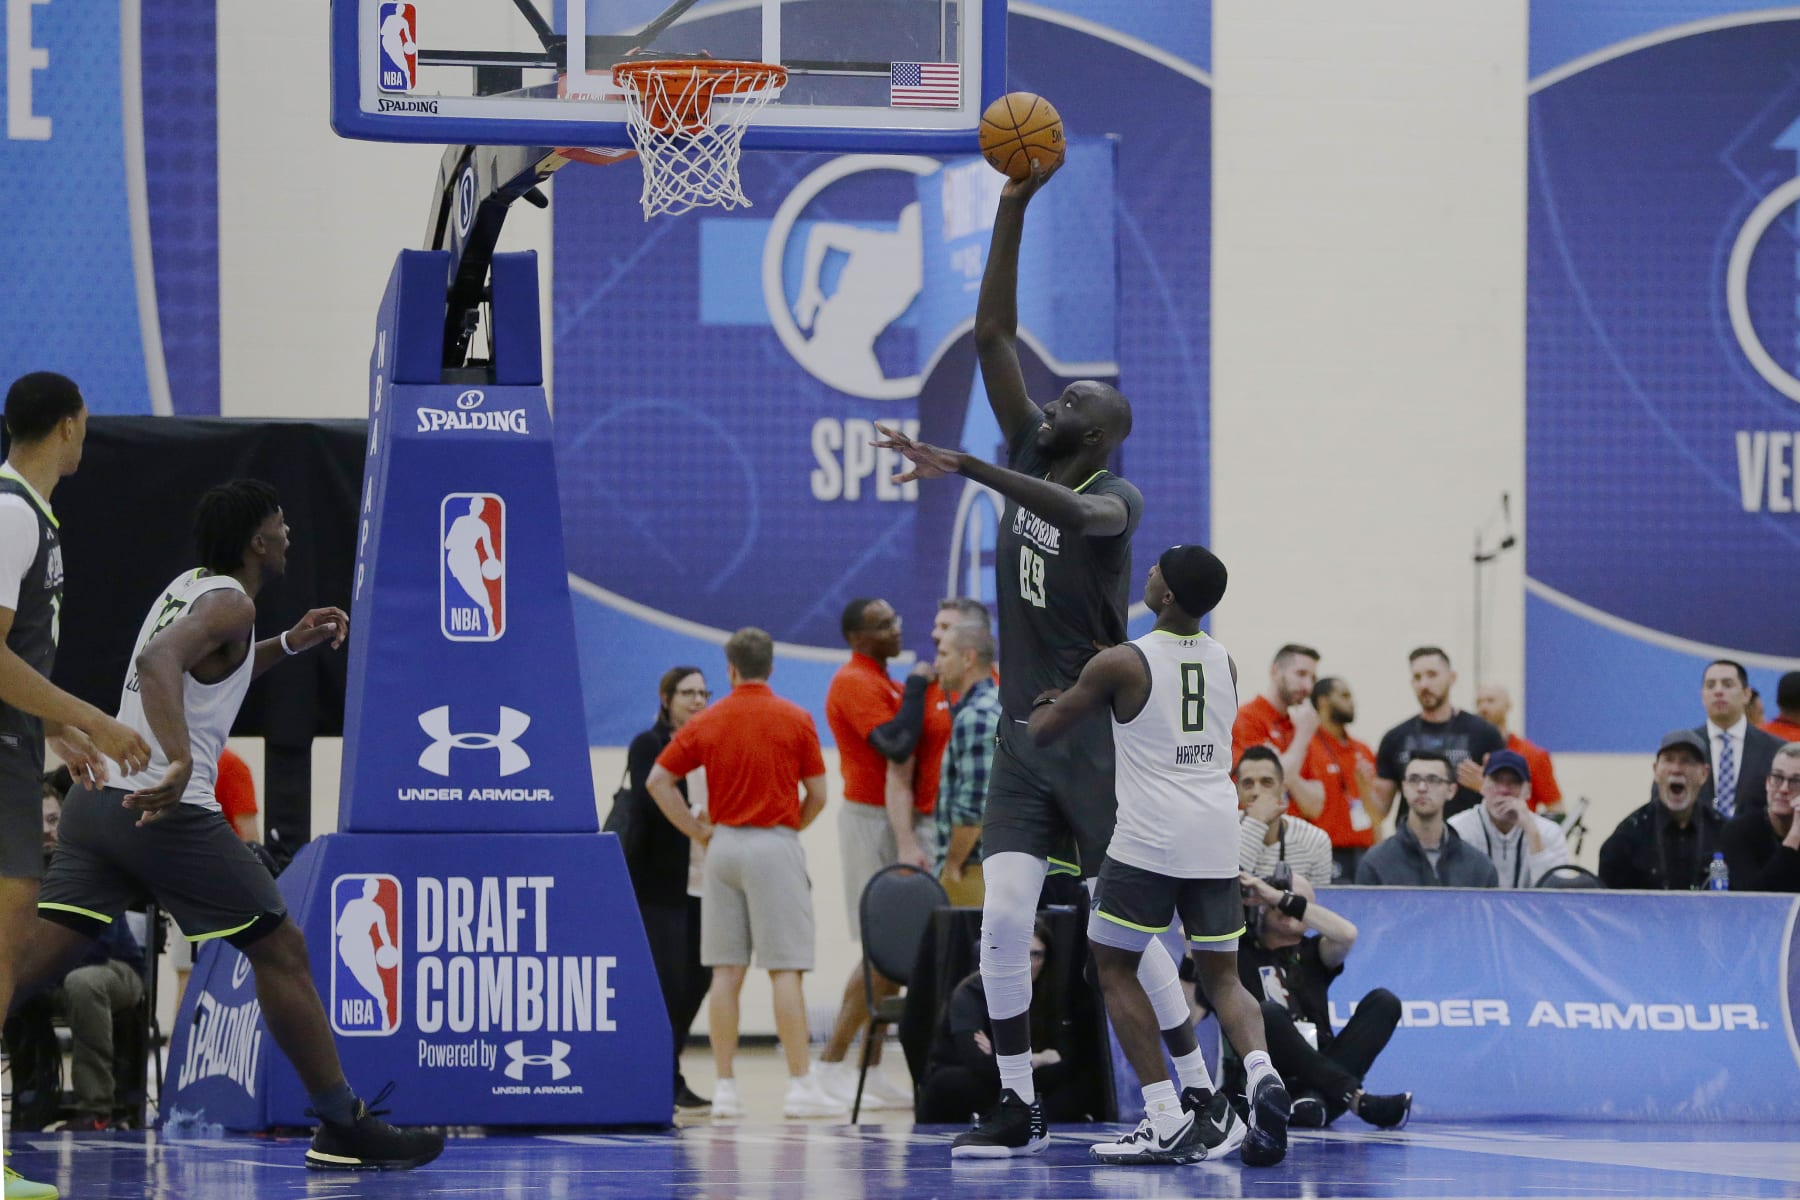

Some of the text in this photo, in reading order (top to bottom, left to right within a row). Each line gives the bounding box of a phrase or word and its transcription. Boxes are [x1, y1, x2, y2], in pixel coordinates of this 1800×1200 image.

[384, 71, 403, 86] NBA
[378, 98, 438, 114] SPALDING
[355, 330, 386, 601] NBA APP
[451, 607, 481, 631] NBA
[1180, 661, 1205, 732] 8
[1175, 744, 1214, 765] HARPER
[398, 787, 463, 801] UNDER
[416, 876, 555, 953] DRAFT
[416, 956, 617, 1033] COMBINE
[341, 999, 375, 1025] NBA
[1327, 999, 1512, 1028] UDER
[418, 1039, 497, 1071] Powered by
[492, 1086, 531, 1095] UNDER
